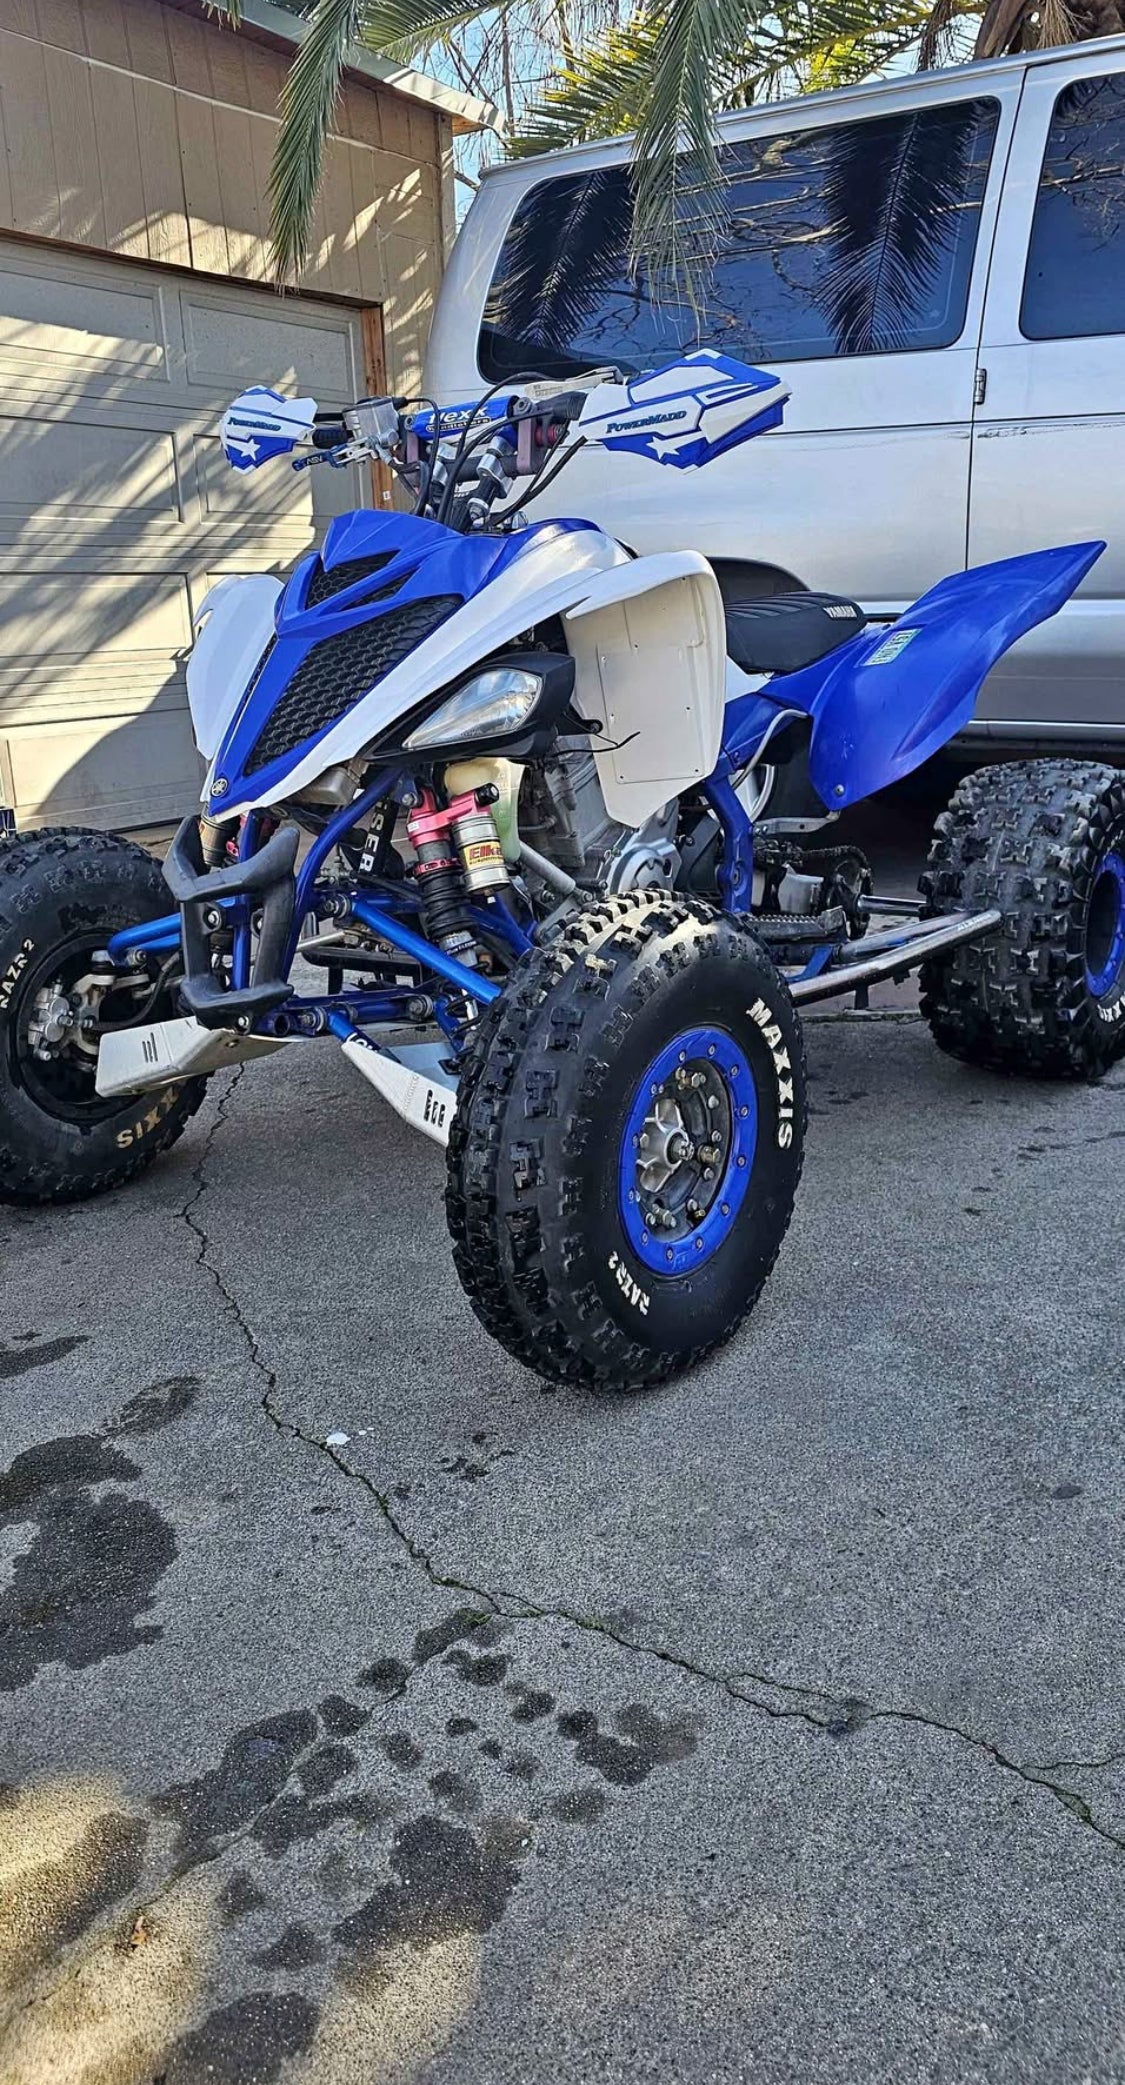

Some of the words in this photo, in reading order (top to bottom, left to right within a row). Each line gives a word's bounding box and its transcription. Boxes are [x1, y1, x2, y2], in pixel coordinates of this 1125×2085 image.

[23, 938, 35, 952] 2
[745, 998, 794, 1150] MAXXIS
[116, 1085, 181, 1149] XXIS
